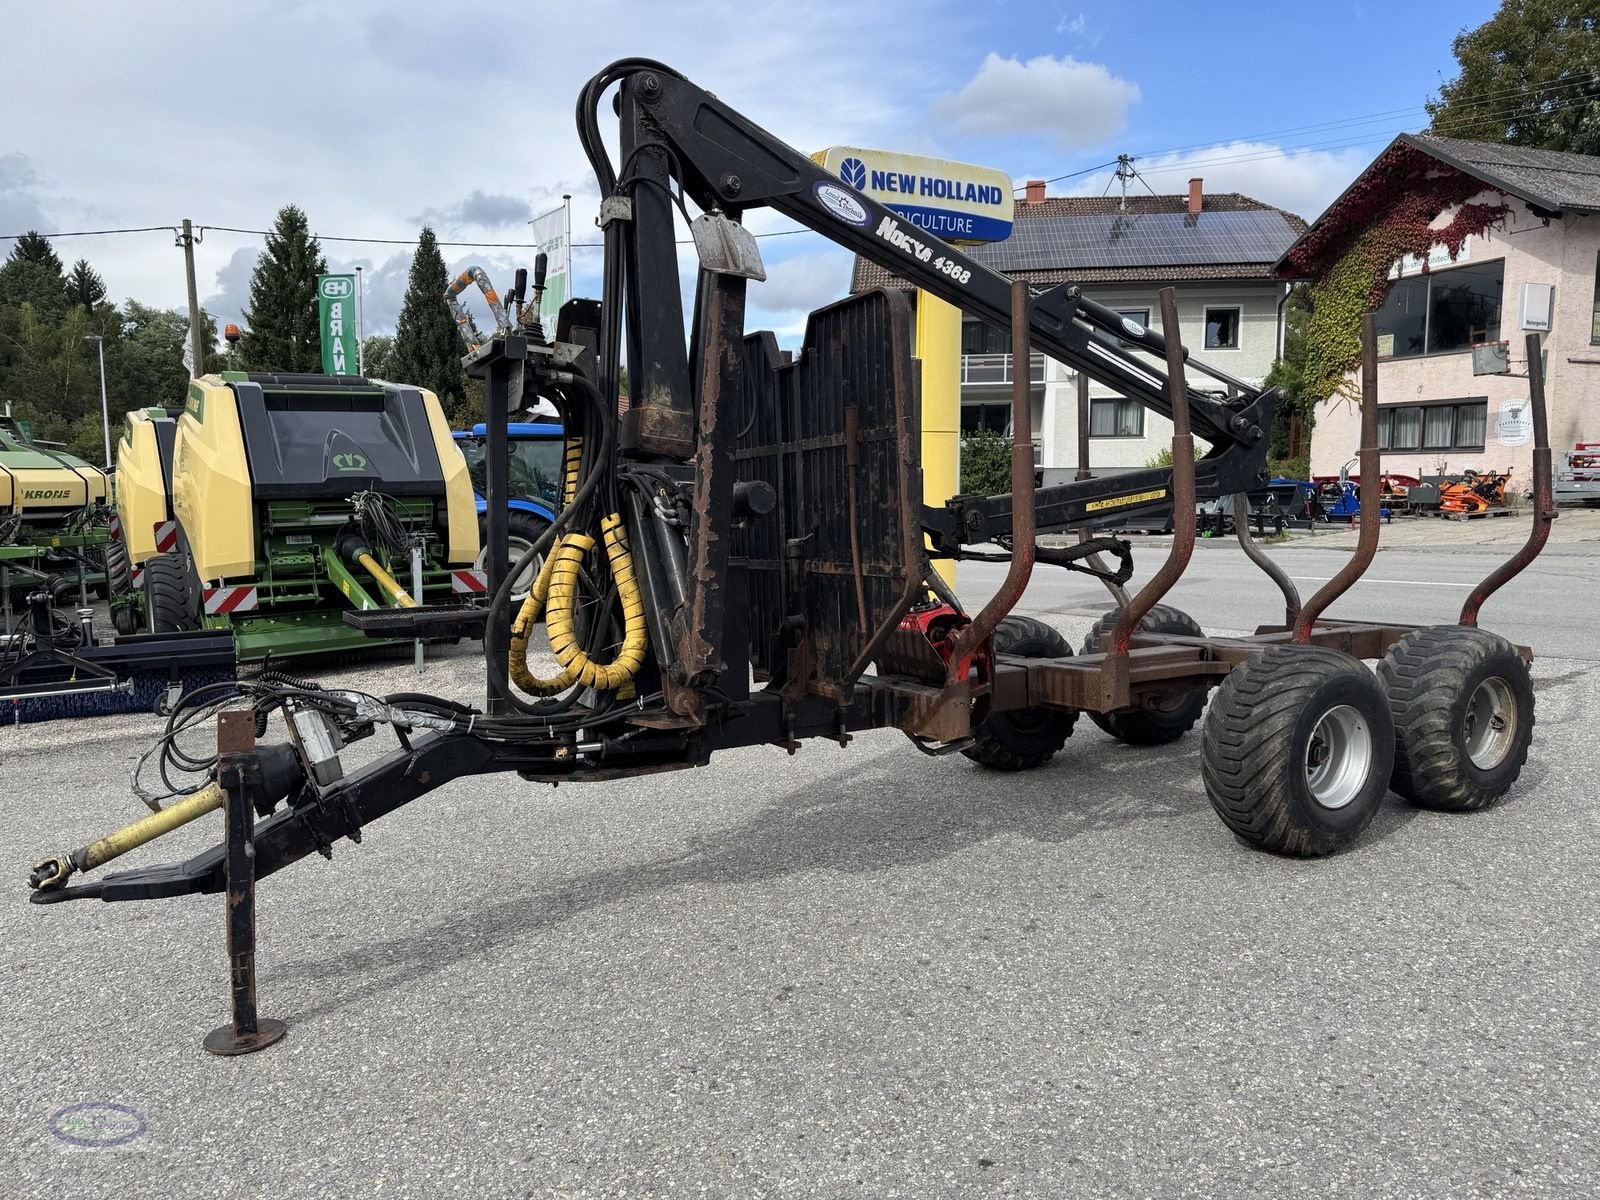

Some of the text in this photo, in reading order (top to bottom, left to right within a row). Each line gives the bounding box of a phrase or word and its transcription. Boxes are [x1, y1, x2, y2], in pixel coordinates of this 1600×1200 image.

[871, 170, 916, 194] NEW
[920, 176, 1002, 205] HOLLAND
[897, 211, 973, 233] ICULTURE
[932, 255, 972, 285] 4368
[24, 489, 71, 500] KRONE
